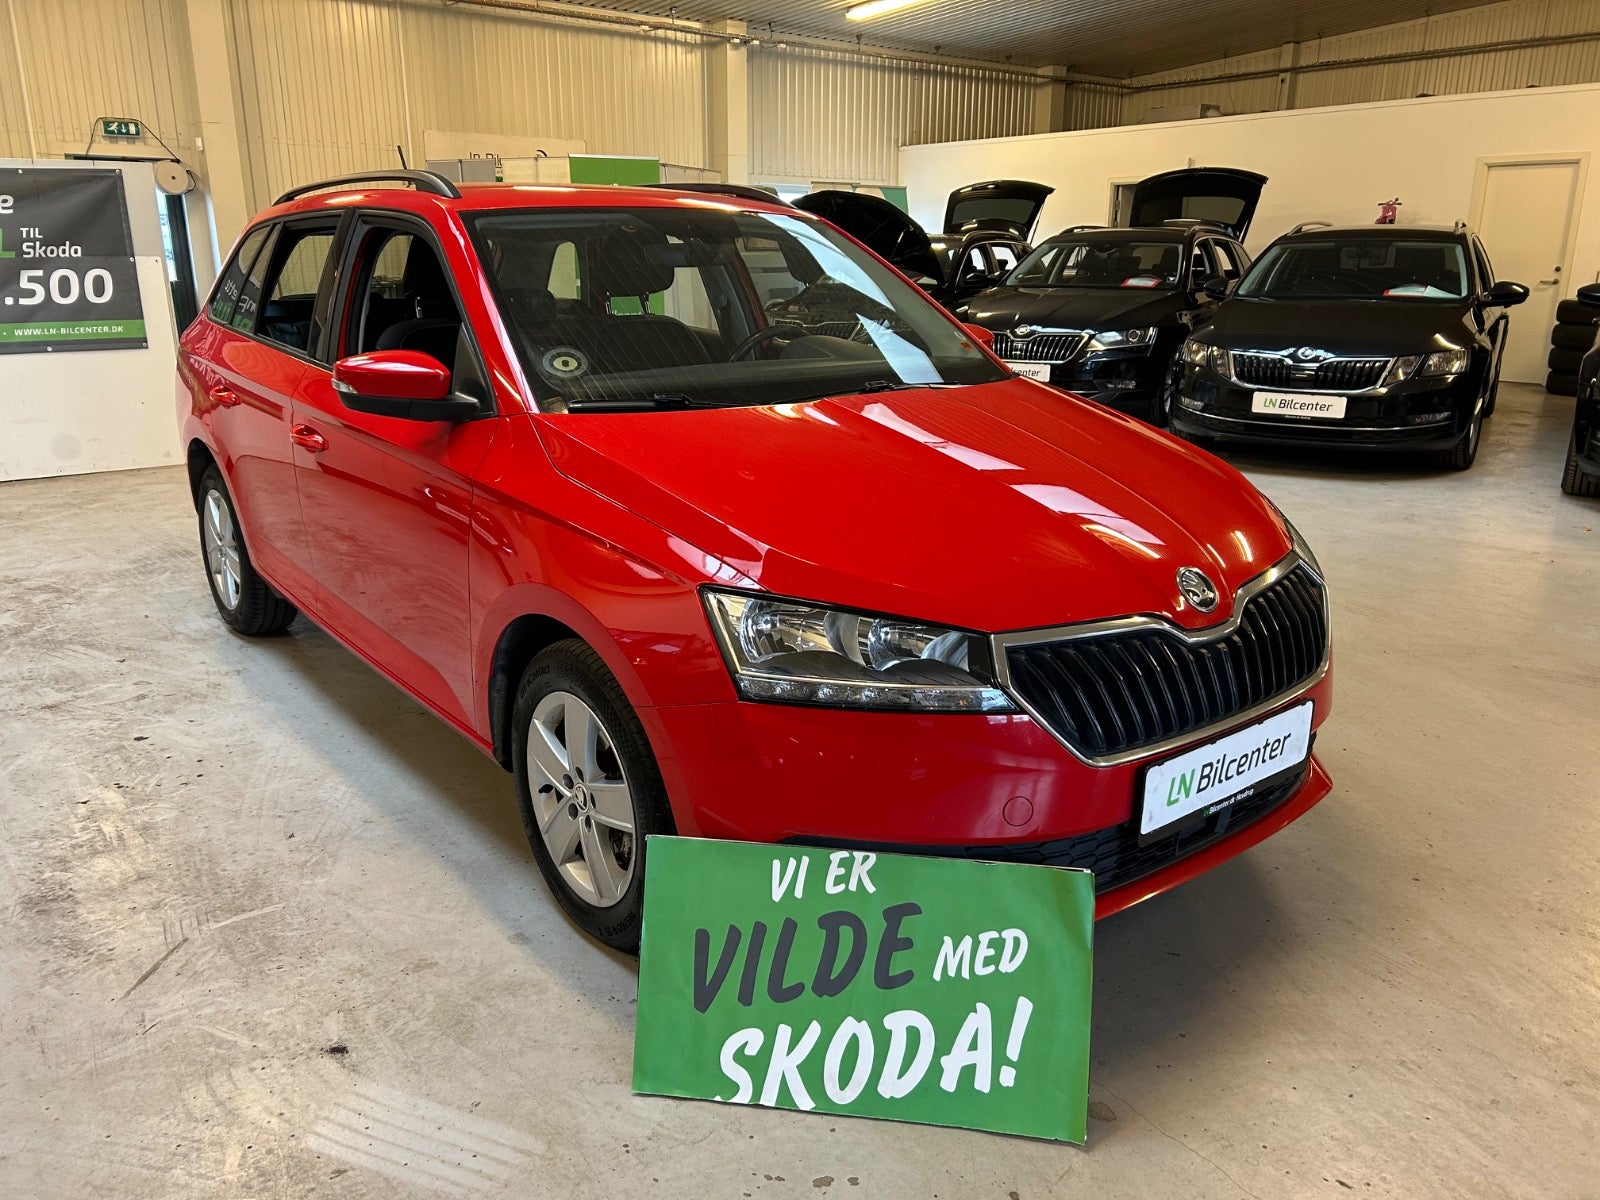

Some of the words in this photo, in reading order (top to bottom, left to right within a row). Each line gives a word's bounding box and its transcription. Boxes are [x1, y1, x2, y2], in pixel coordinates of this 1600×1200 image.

[20, 227, 43, 239] TIL
[22, 241, 82, 258] Skoda
[14, 326, 124, 336] WWW.LN-BILCENTER.DK
[1278, 398, 1333, 412] Bilcenter
[1195, 732, 1292, 795] Bilcenter
[771, 855, 810, 903] VI
[825, 851, 877, 894] ER
[693, 902, 923, 1014] VILDE
[932, 928, 1029, 982] MED
[713, 996, 1034, 1111] SKODA!
